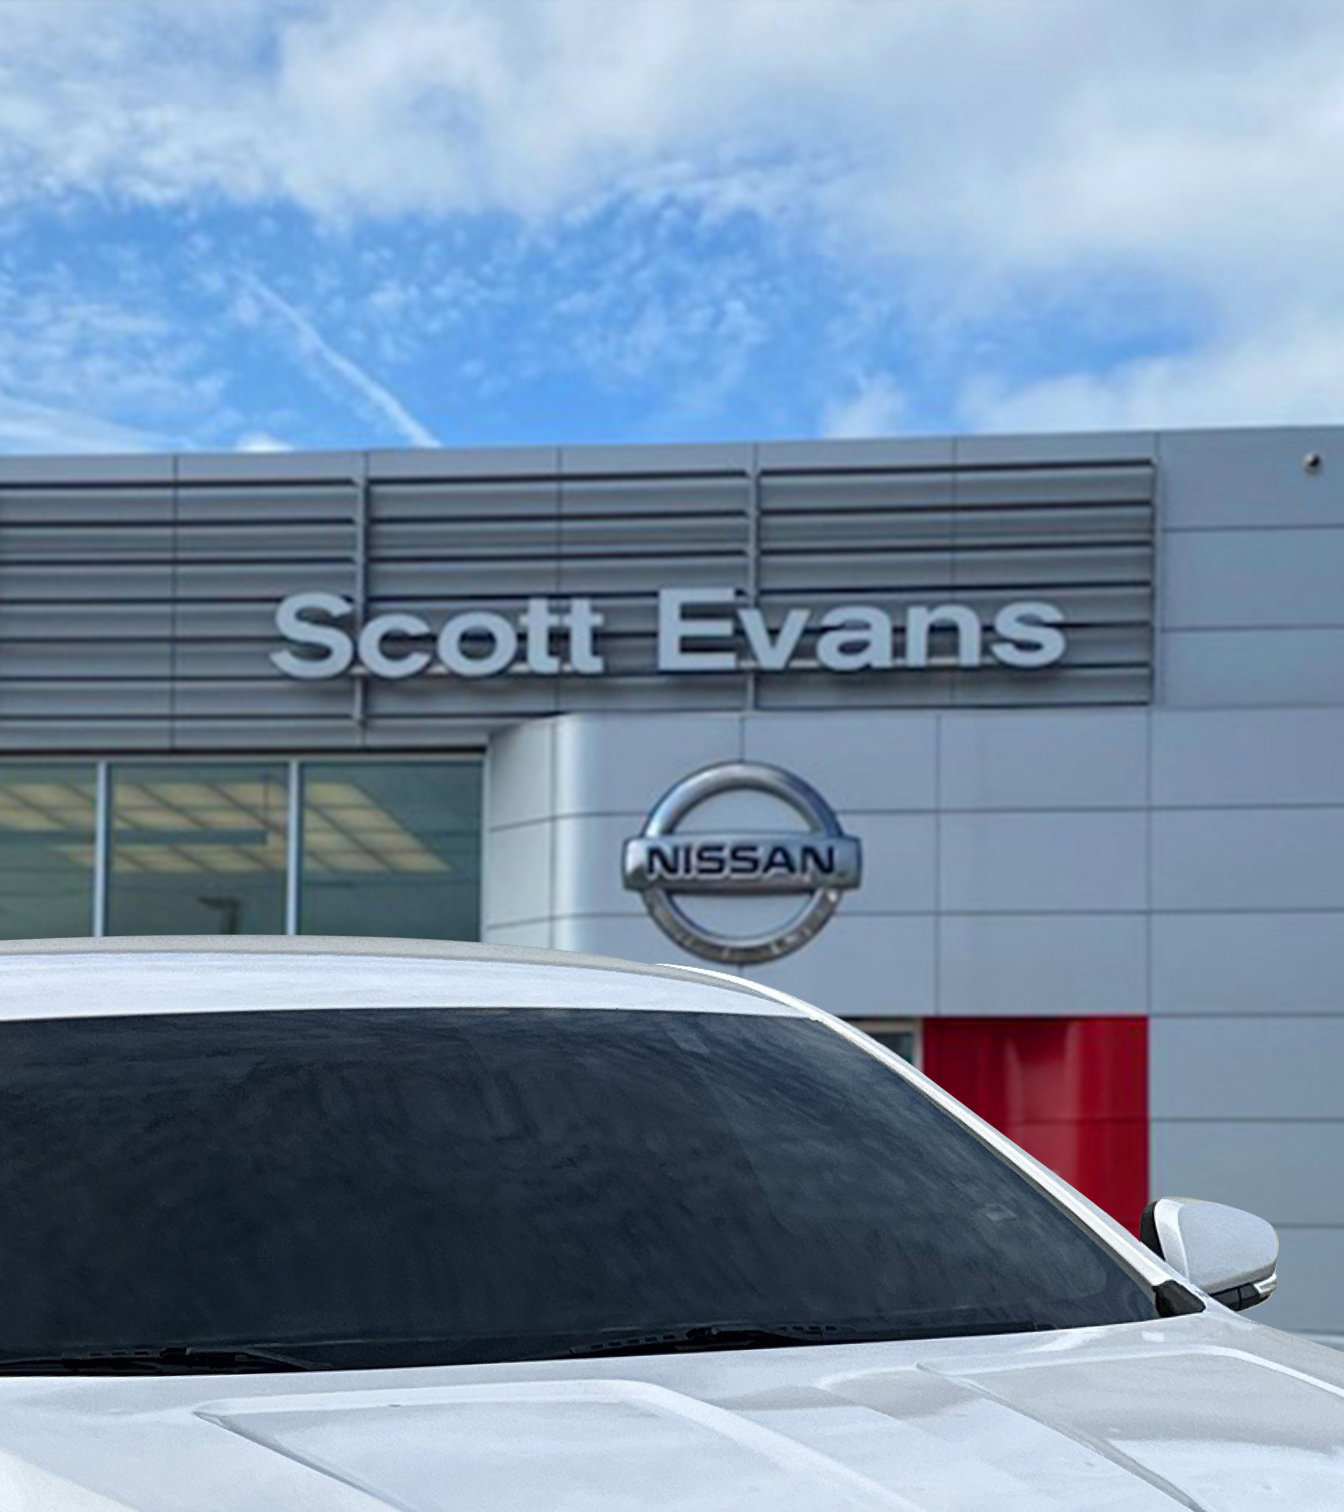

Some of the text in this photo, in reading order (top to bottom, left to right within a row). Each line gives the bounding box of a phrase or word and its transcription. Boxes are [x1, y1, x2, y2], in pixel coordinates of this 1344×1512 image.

[269, 587, 1067, 678] Scott Evans
[646, 845, 835, 876] NISSAN
